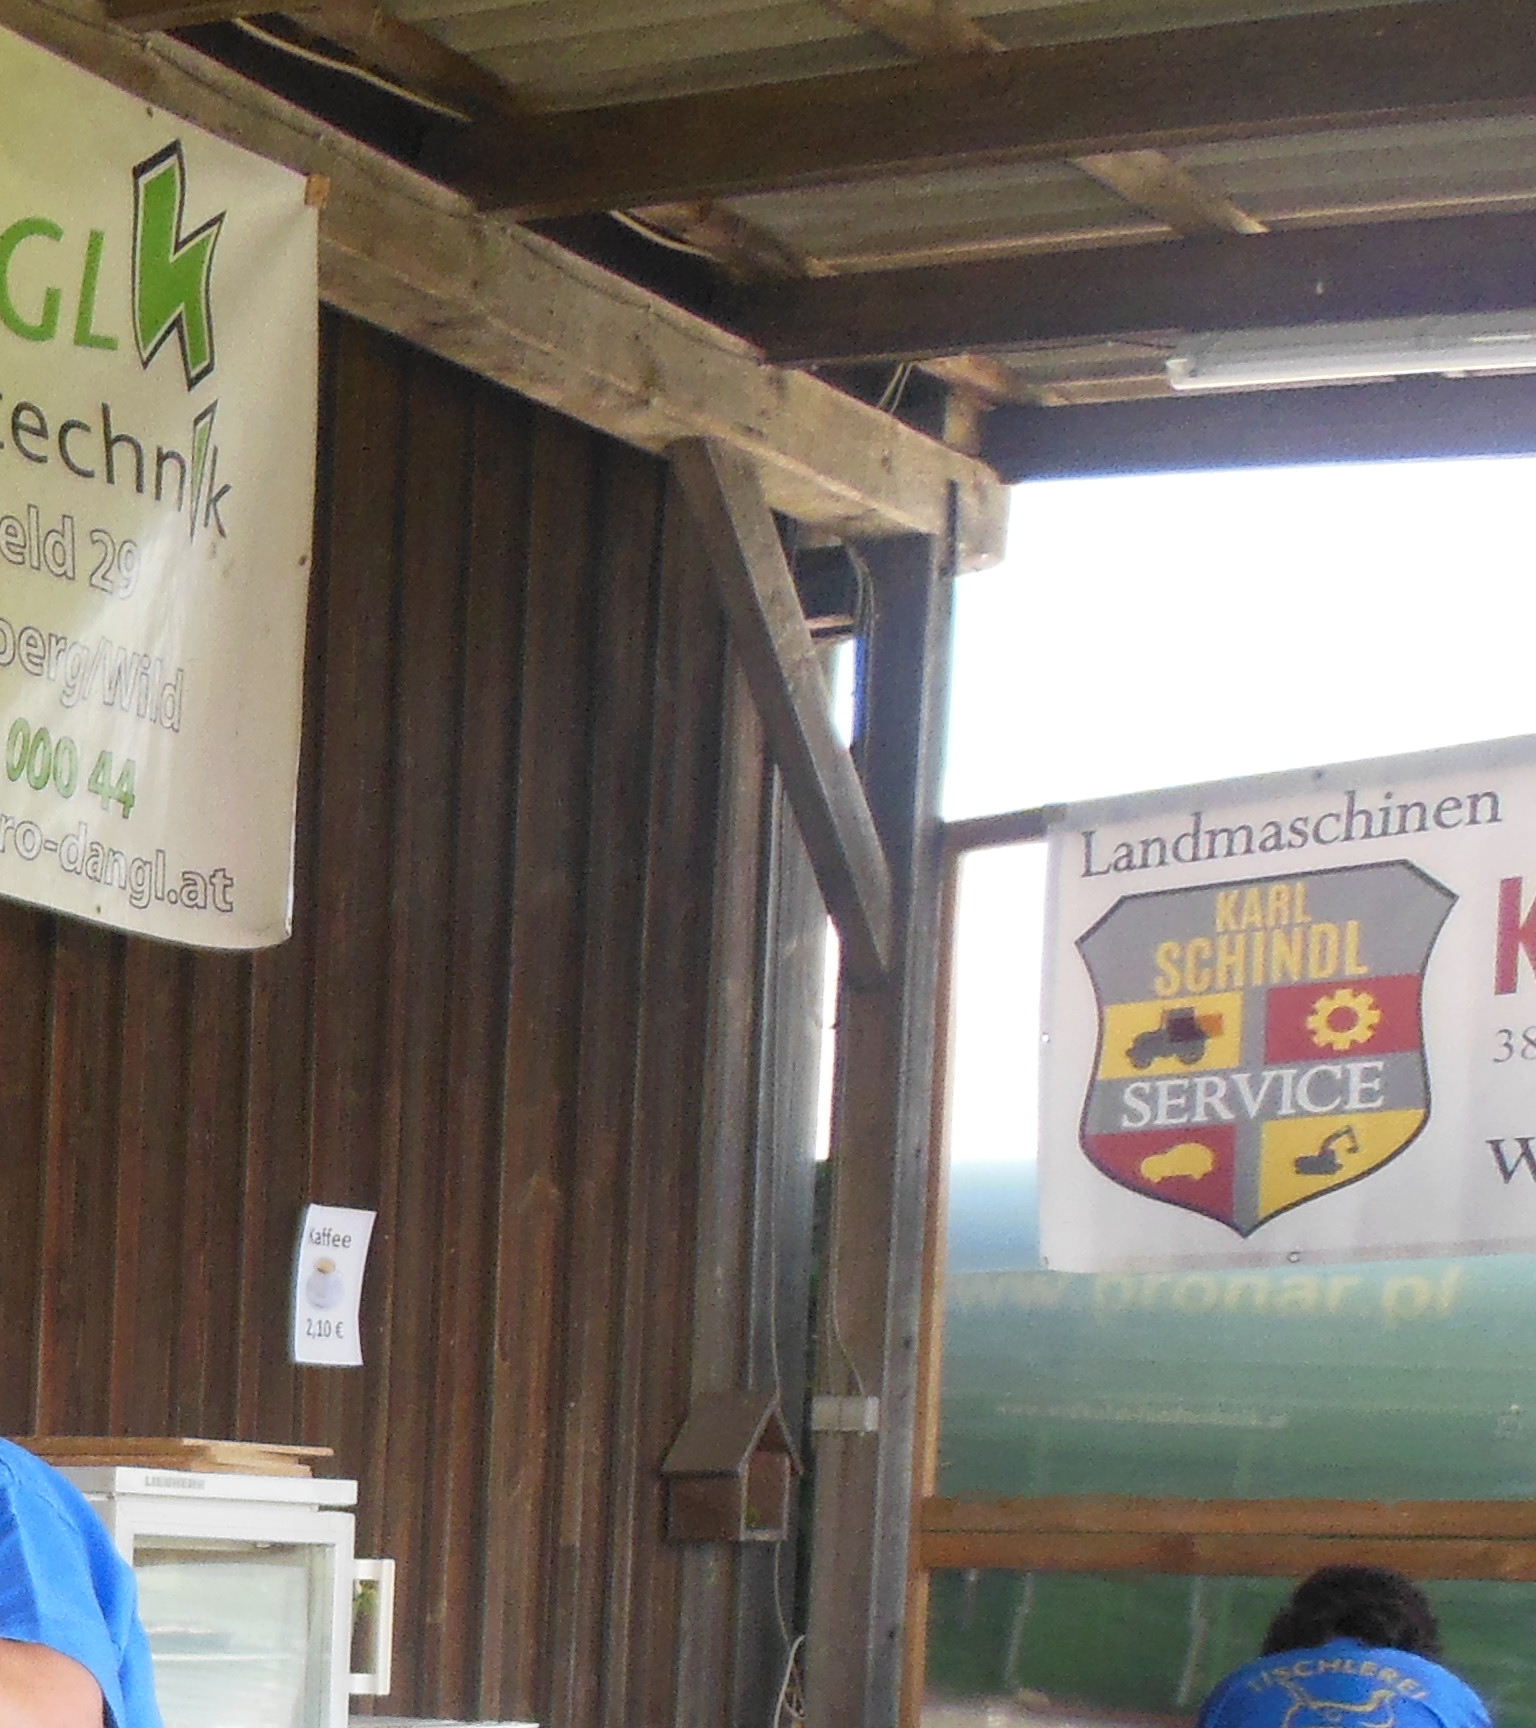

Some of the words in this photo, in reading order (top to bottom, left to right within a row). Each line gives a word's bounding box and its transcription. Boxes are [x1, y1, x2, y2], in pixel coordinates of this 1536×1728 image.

[89, 528, 141, 600] 29
[6, 717, 78, 799] 000
[87, 750, 136, 820] 44
[1080, 790, 1501, 878] Landmaschinen
[1214, 883, 1312, 932] KARL
[1154, 921, 1368, 998] SCHINDL
[1120, 1061, 1384, 1130] SERVICE
